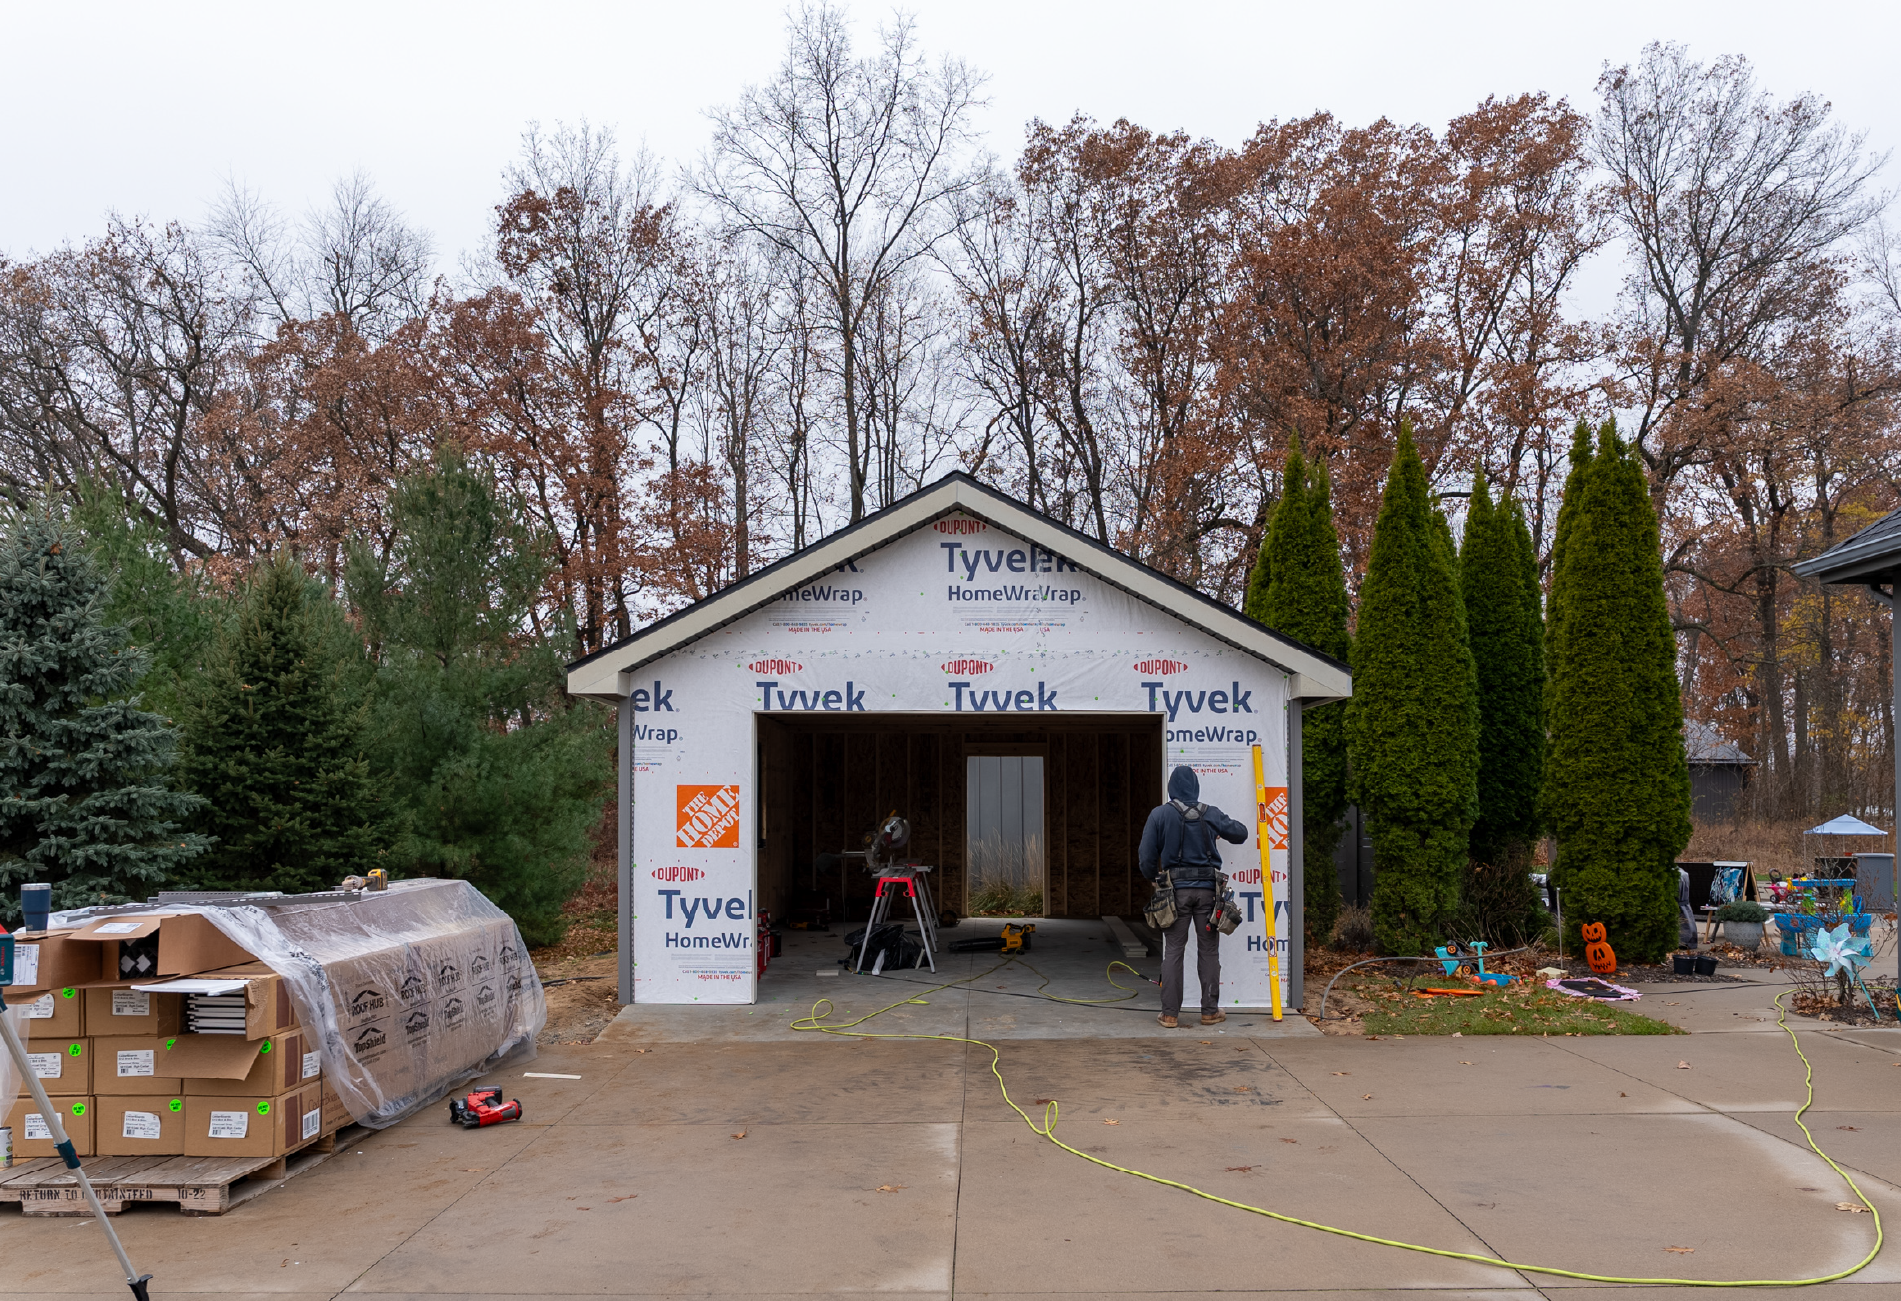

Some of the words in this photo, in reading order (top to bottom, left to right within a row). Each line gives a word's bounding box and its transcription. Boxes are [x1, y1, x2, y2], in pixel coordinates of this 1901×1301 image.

[940, 519, 980, 535] DUPONT
[755, 659, 797, 675] DUPONT
[947, 659, 989, 675] DUPONT
[1140, 659, 1182, 675] DUPONT
[630, 680, 674, 712] ek
[1141, 681, 1253, 722] Tyvek
[681, 791, 710, 817] THE
[676, 785, 739, 848] HOME
[700, 807, 739, 848] DEPOT
[657, 866, 699, 882] DUPONT
[1238, 868, 1281, 885] DUPNT
[657, 889, 752, 928] Tyve
[665, 932, 752, 948] HomeWr
[351, 1001, 368, 1017] ROOF
[370, 997, 384, 1011] HUB
[354, 1033, 387, 1054] TopShield
[20, 1189, 60, 1200] RETURN
[65, 1189, 78, 1200] TO
[82, 1188, 153, 1200] RTAINTEED
[177, 1188, 206, 1200] 10-22
